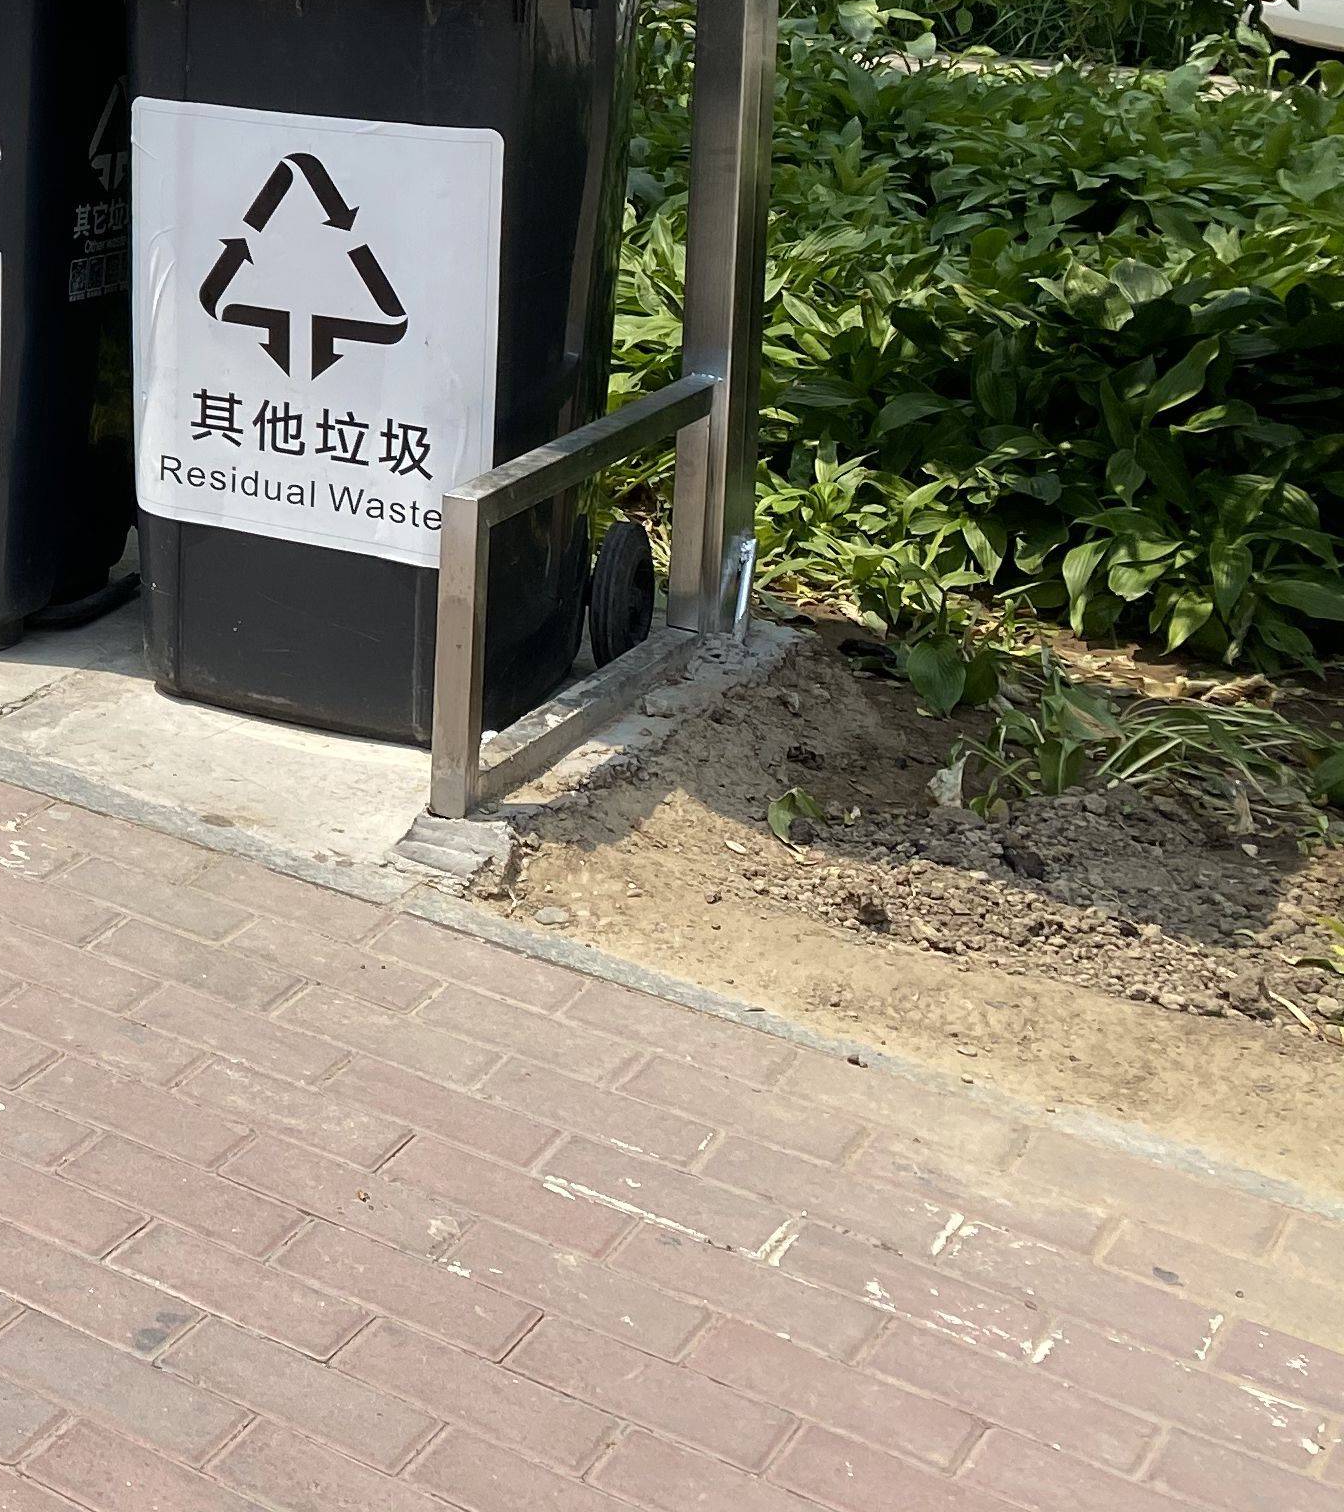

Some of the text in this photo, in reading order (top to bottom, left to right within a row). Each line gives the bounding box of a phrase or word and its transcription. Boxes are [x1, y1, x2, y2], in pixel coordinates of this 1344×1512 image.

[73, 198, 129, 239] 其它垃
[190, 388, 435, 482] 其他垃圾
[159, 453, 442, 531] Residual Waste
